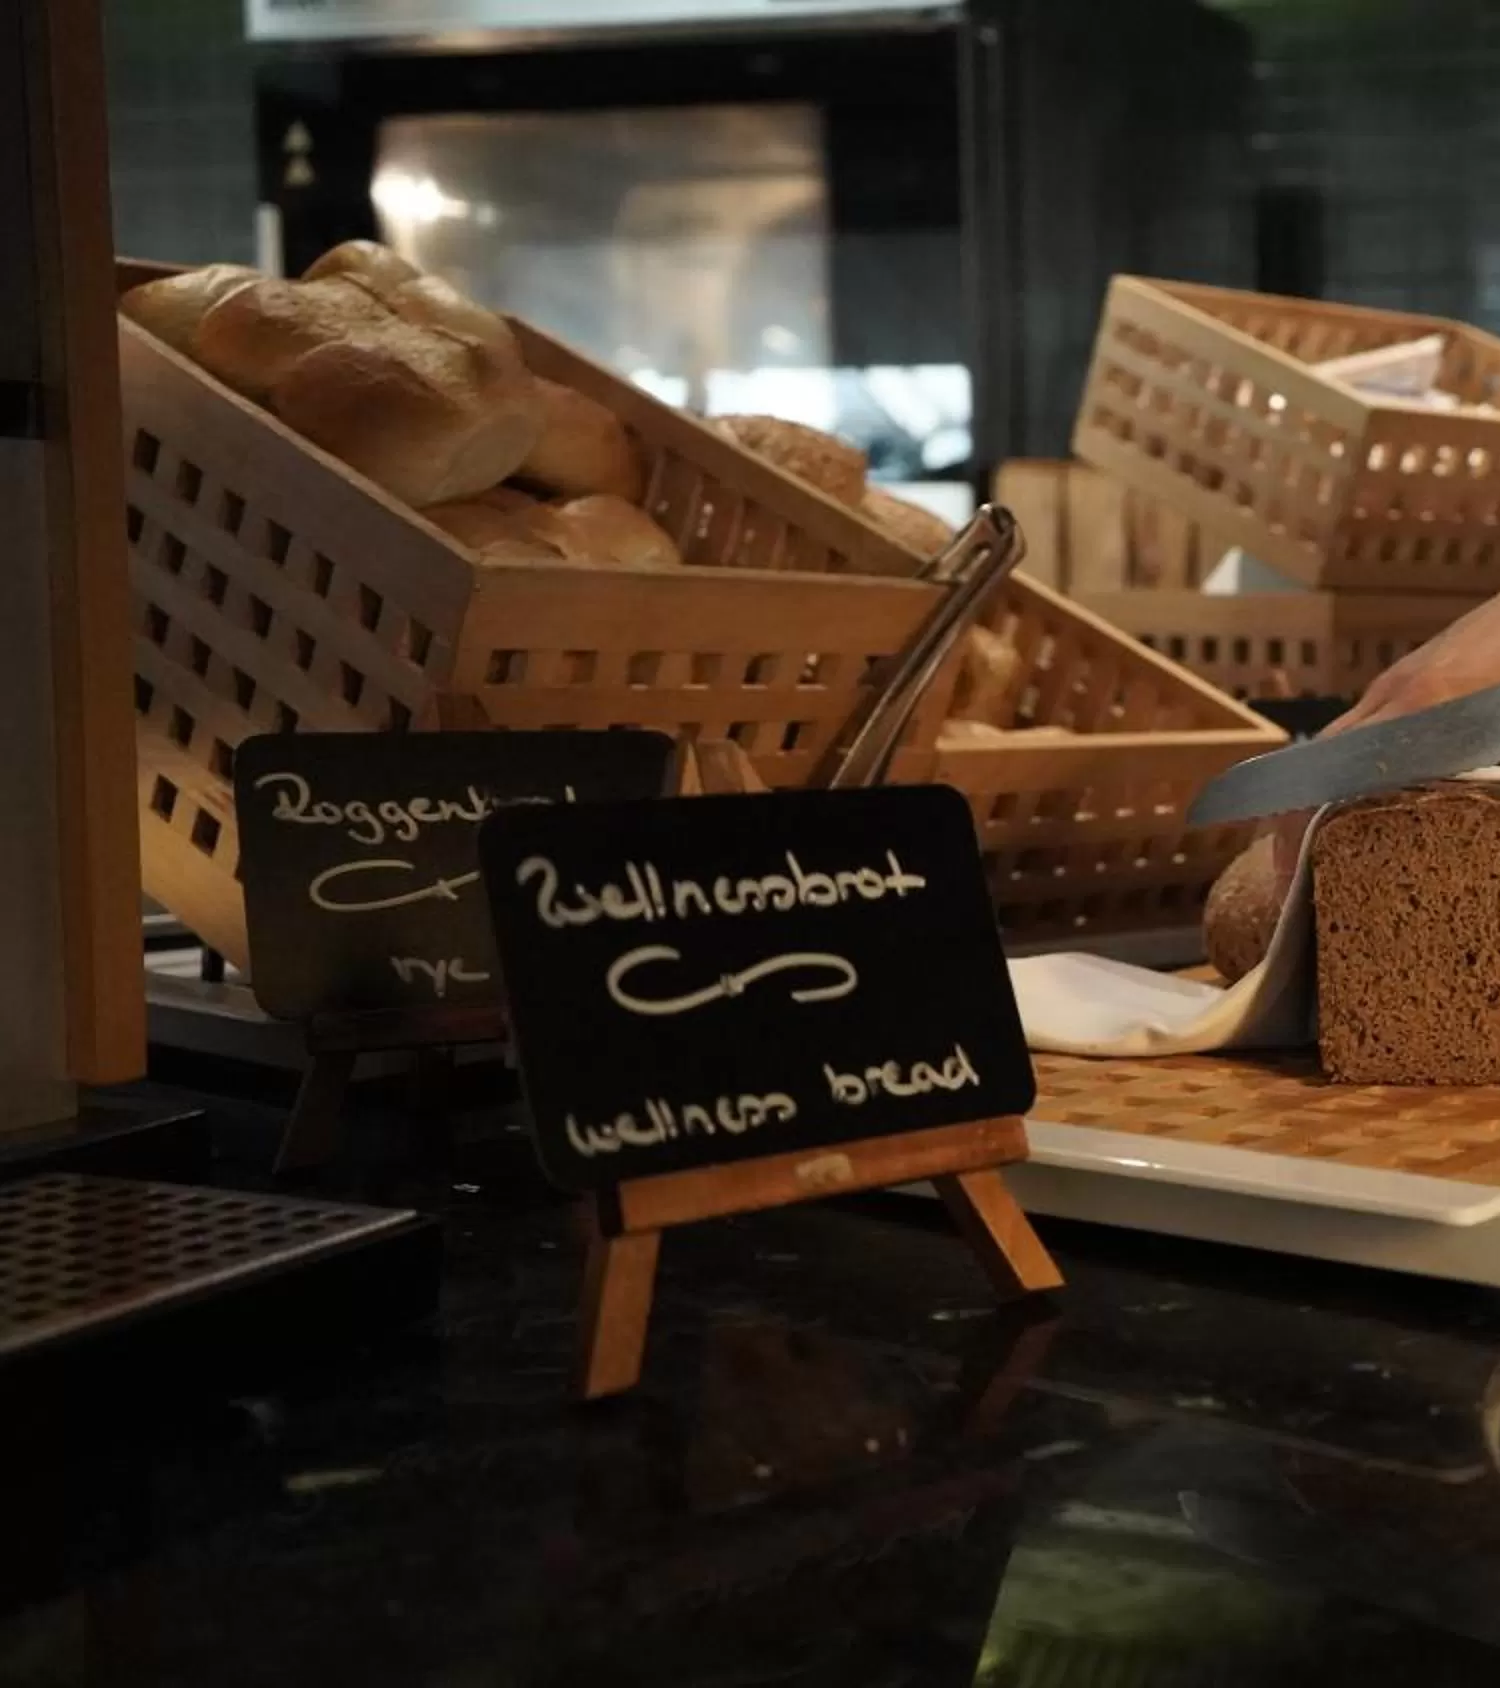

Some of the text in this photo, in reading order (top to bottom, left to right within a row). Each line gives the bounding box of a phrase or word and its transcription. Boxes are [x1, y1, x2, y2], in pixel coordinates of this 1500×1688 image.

[254, 772, 576, 844] Roggenb
[516, 849, 926, 928] Wellnessbrot
[823, 1043, 980, 1104] bread
